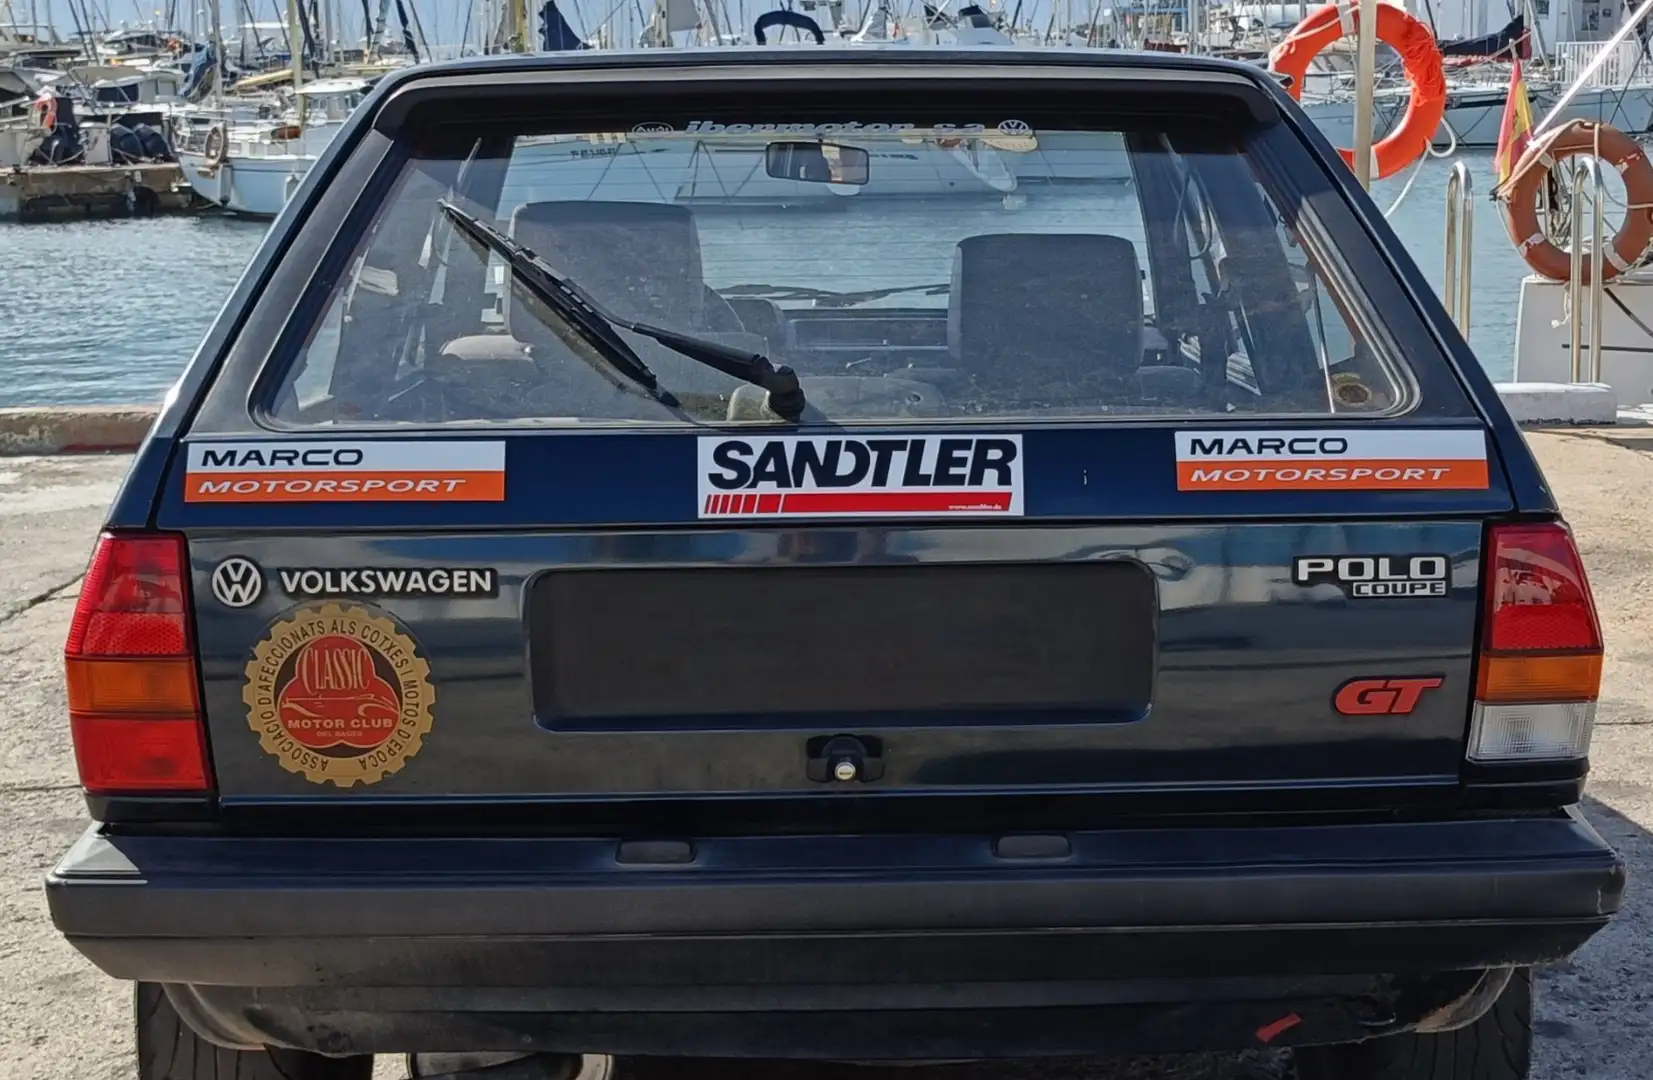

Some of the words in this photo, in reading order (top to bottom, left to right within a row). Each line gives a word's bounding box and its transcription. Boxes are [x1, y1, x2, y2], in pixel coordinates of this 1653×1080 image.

[1190, 437, 1349, 455] MARCO
[201, 448, 364, 466] MARCO
[708, 438, 1018, 490] SANDTLER
[1190, 468, 1451, 482] MOTORSPORT
[198, 479, 467, 493] MOTORSPORT
[1298, 556, 1446, 581] POLO
[280, 569, 492, 594] VOLKSWAGEN
[1355, 582, 1445, 596] COUPE
[332, 619, 358, 634] ALS
[361, 624, 409, 669] COTXES
[402, 679, 421, 728] MOTOS
[1335, 678, 1444, 714] GT
[288, 718, 345, 729] MOTOR
[350, 718, 393, 729] CLUB
